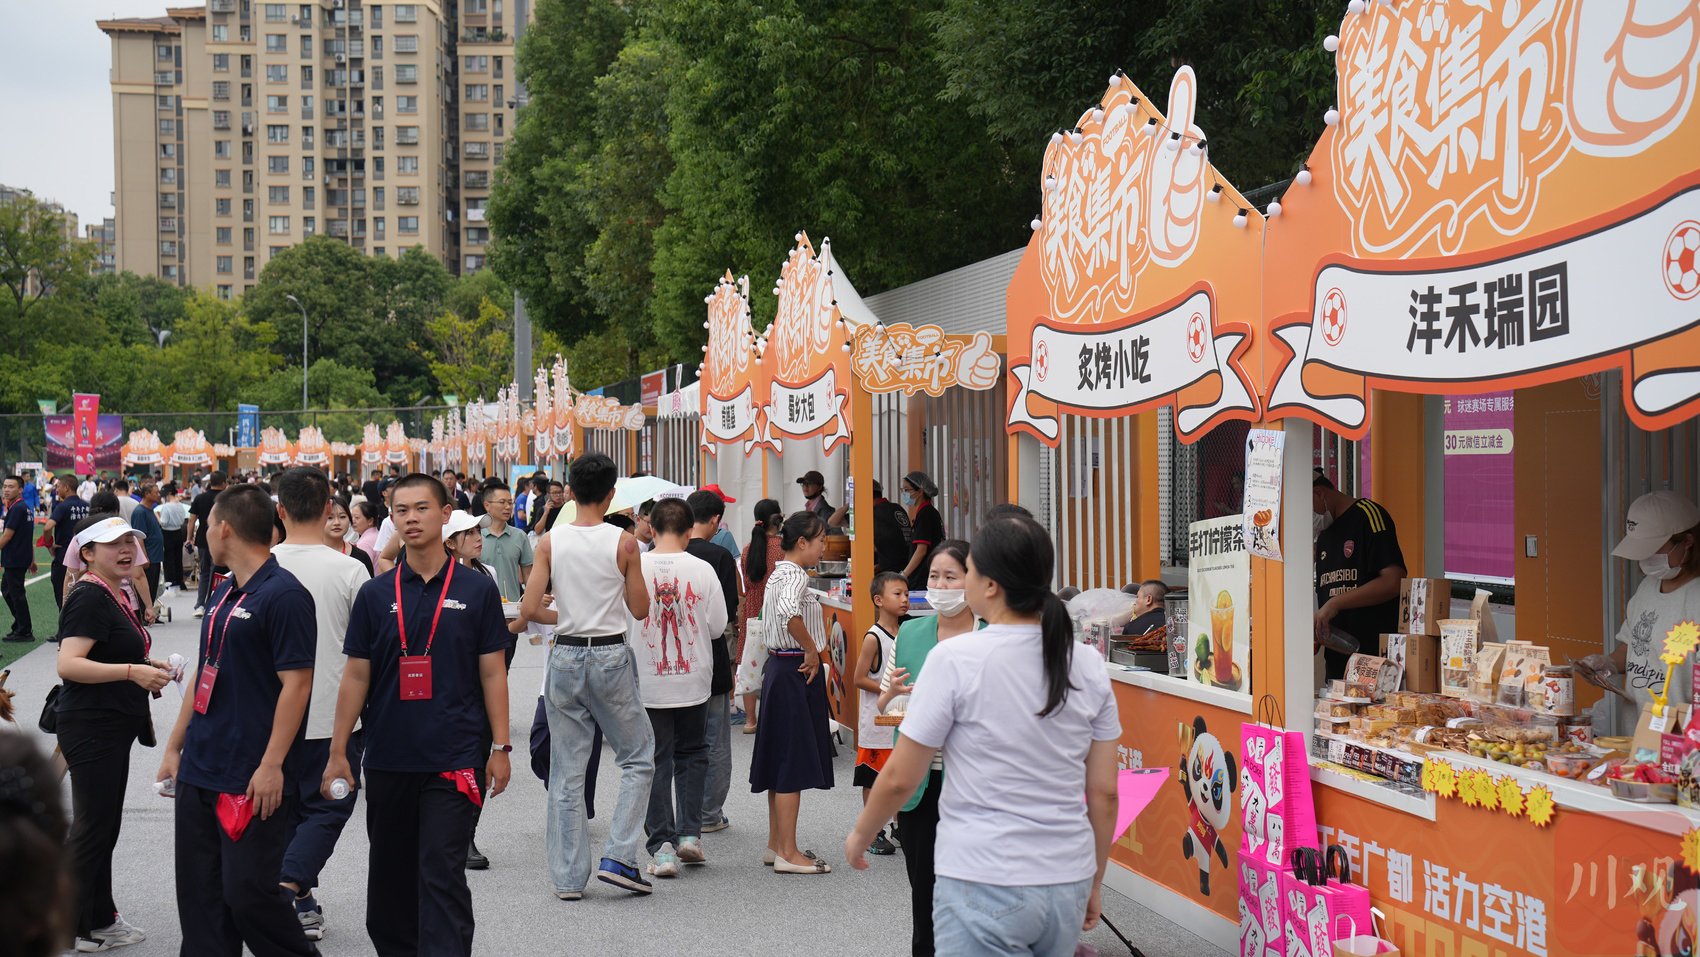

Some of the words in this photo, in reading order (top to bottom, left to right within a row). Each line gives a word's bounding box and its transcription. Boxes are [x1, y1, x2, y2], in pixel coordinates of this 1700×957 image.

[1347, 5, 1557, 213] 美食集市
[1045, 150, 1144, 291] 美食集市
[1406, 261, 1570, 355] 沣禾瑞园
[859, 334, 956, 389] 美食集市
[1077, 334, 1152, 391] 炙烤小吃
[1190, 523, 1246, 558] 手打柠檬茶
[1422, 858, 1549, 957] 活力空港
